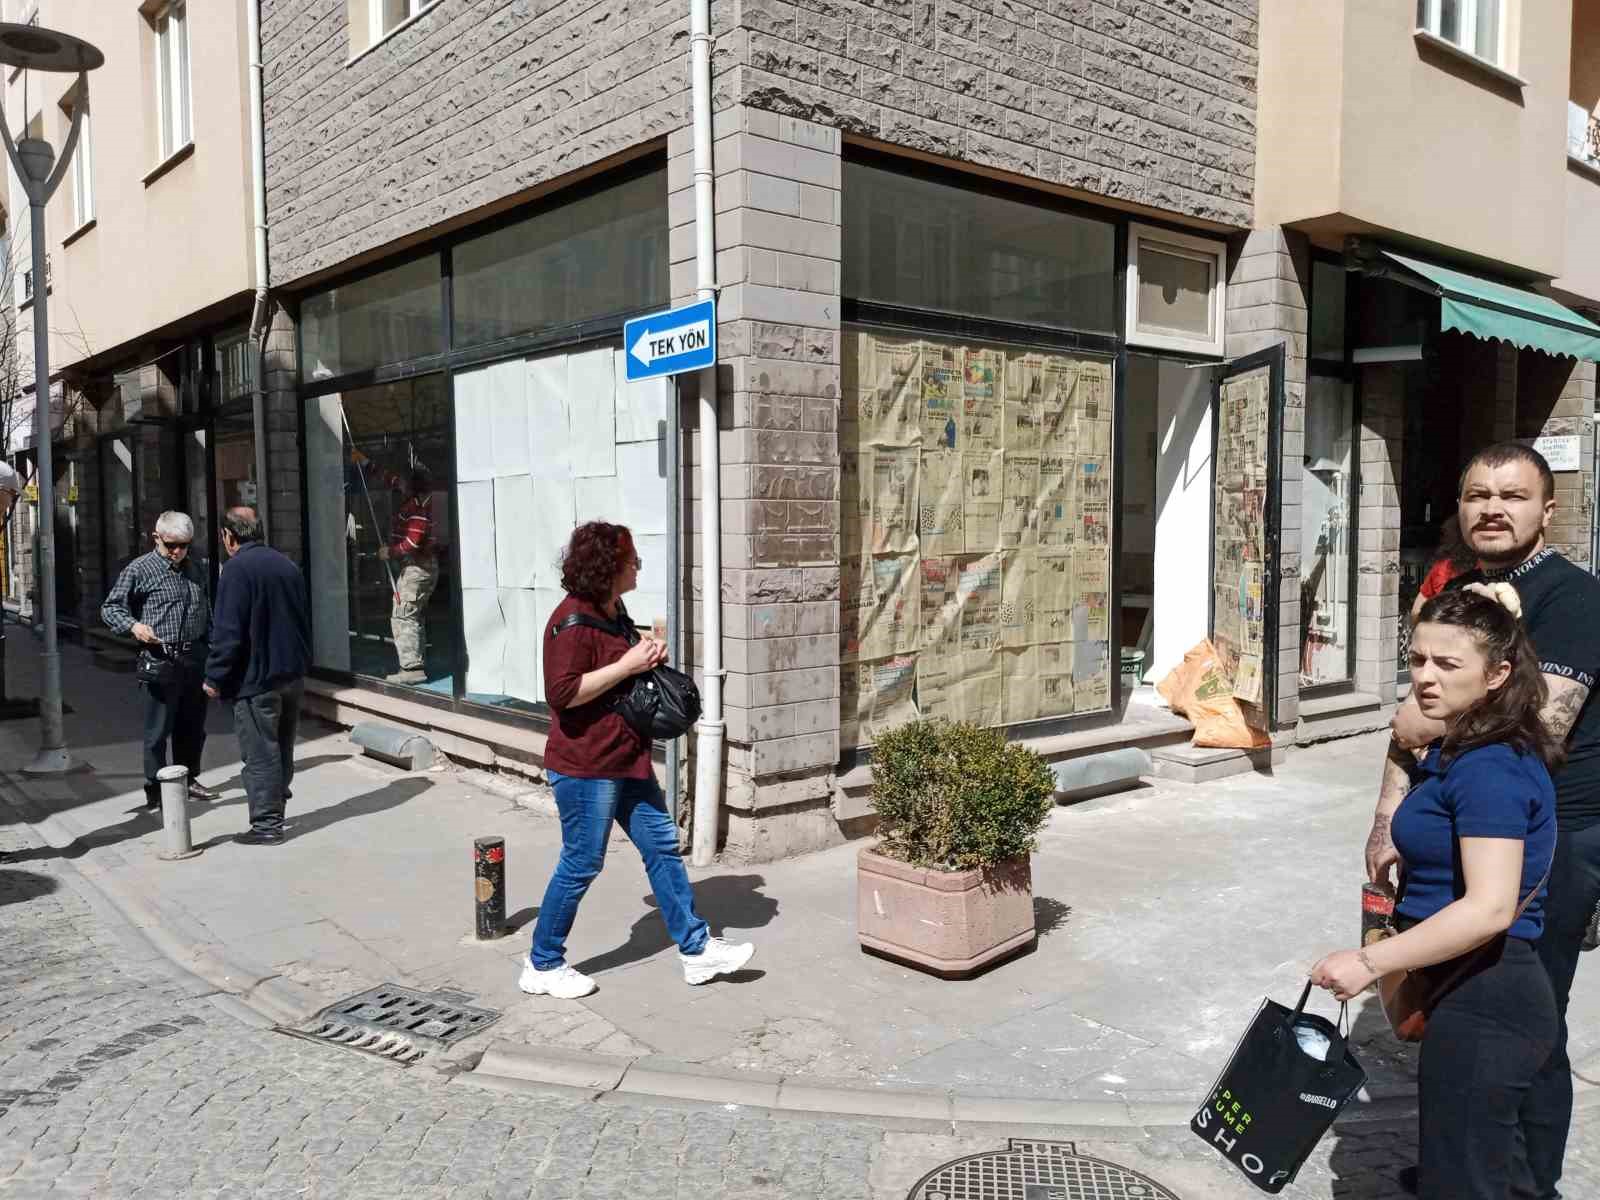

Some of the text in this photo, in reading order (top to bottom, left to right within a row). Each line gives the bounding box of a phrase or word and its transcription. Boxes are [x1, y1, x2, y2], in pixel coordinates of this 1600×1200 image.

[649, 328, 705, 357] TEK YÖN
[1537, 660, 1574, 676] MIND
